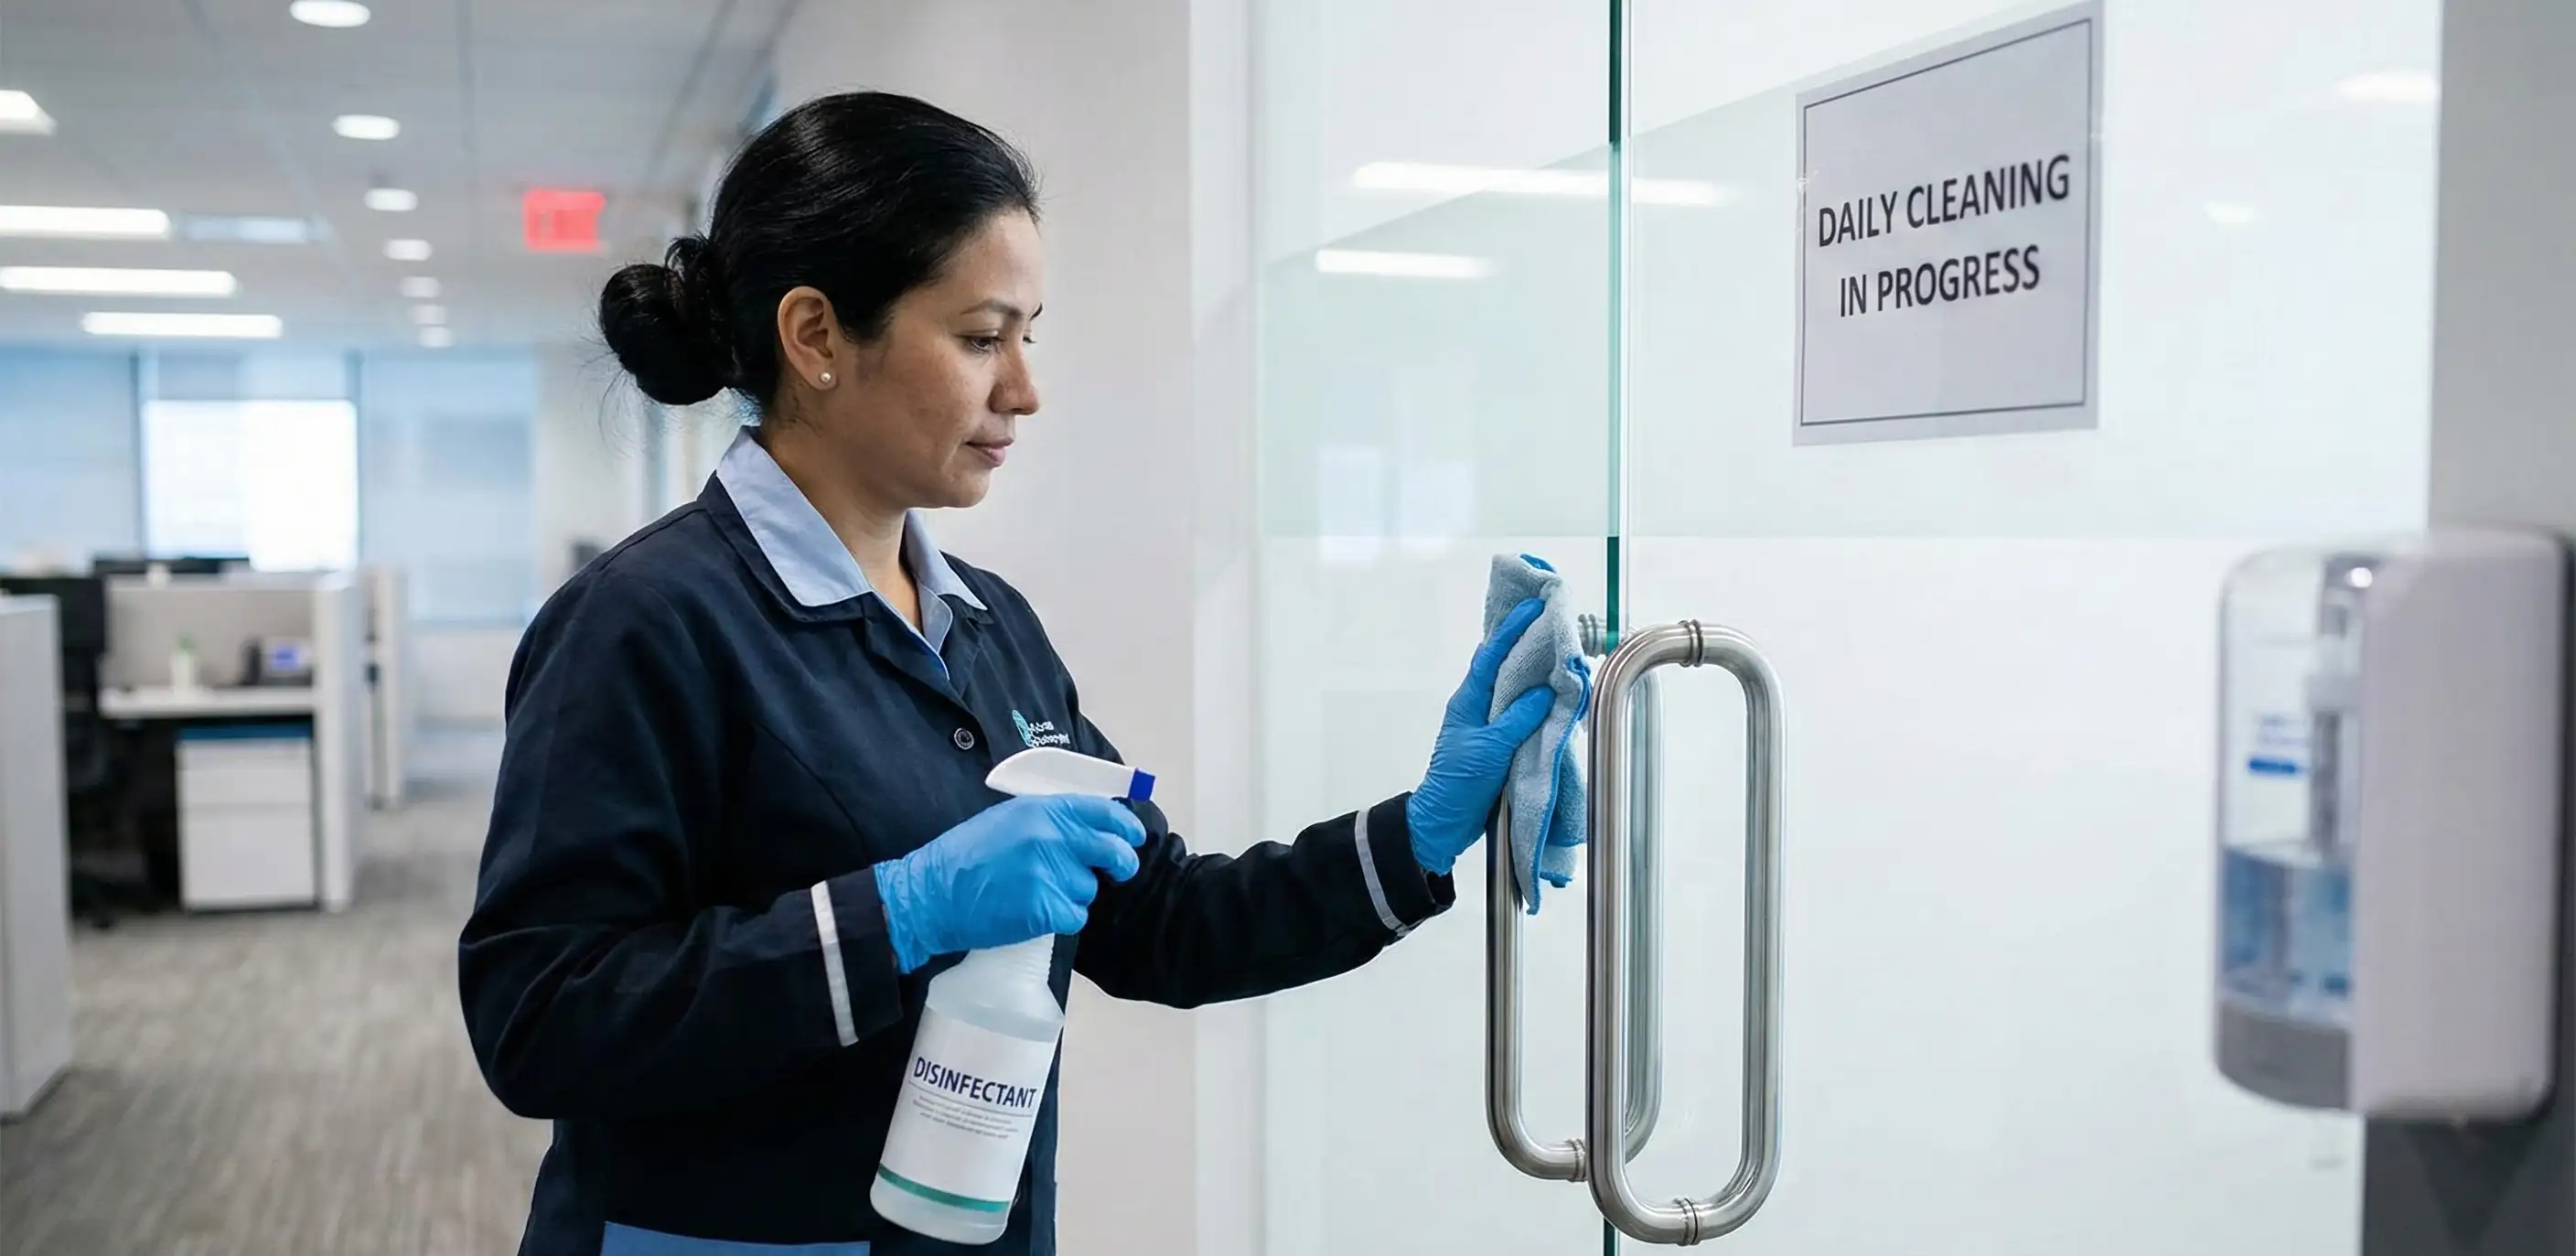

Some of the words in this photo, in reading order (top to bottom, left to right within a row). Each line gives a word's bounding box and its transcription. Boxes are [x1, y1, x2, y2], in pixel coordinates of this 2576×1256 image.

[1819, 190, 1899, 248] DAILY
[1906, 154, 2070, 229] CLEANING
[1841, 274, 1868, 317] IN
[1877, 244, 2040, 312] PROGRESS
[913, 1056, 1037, 1109] DISINFECTANT
